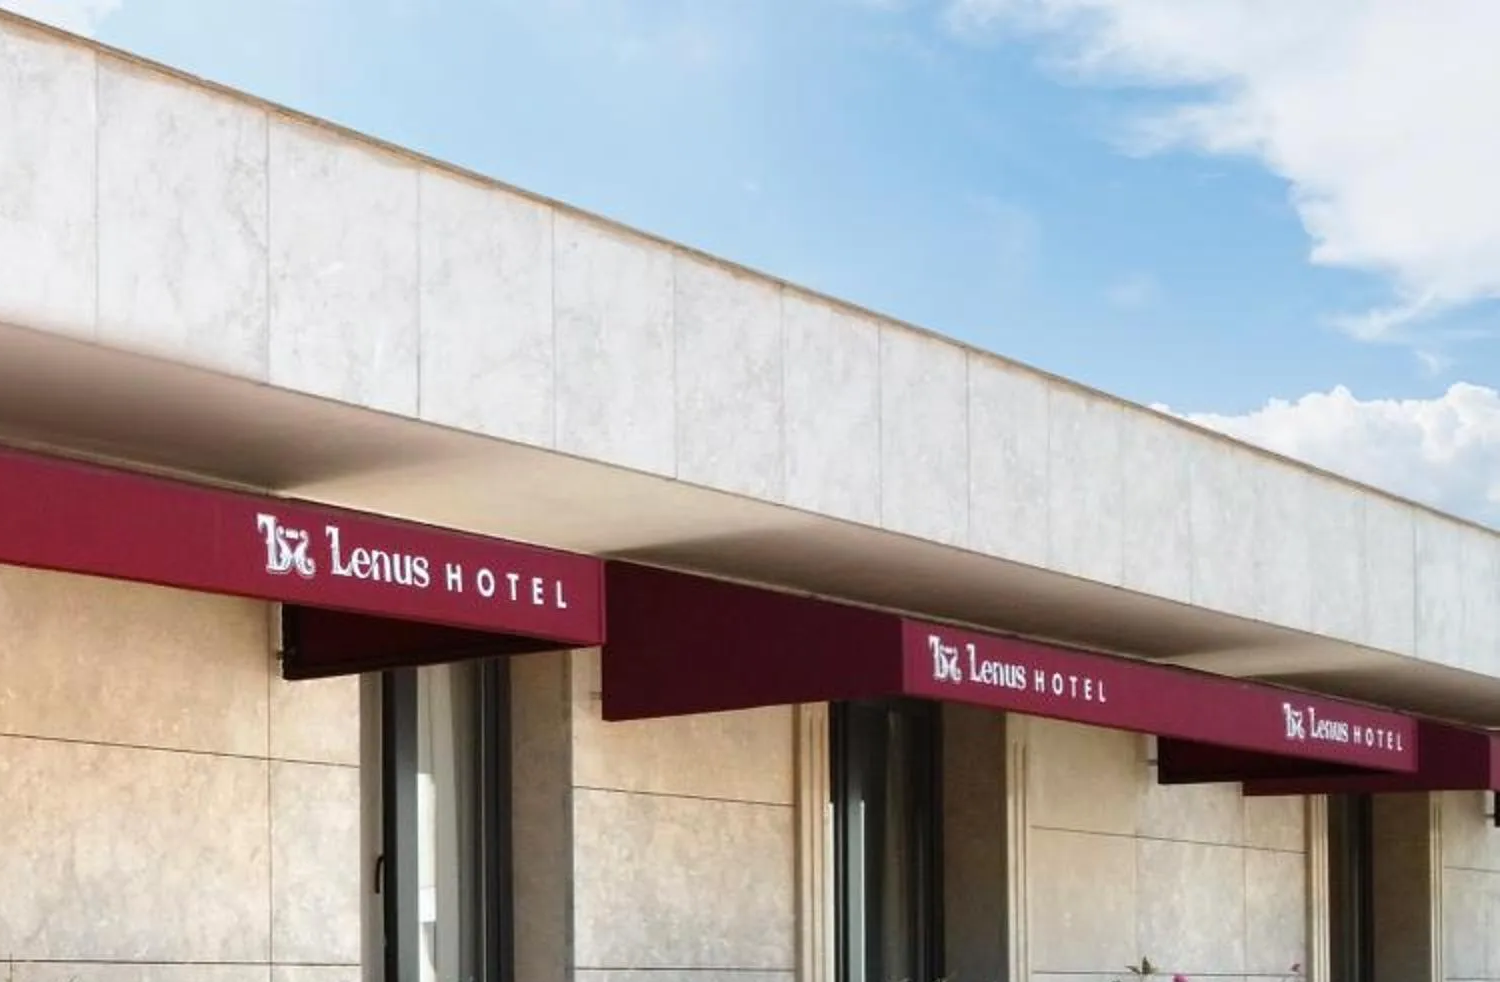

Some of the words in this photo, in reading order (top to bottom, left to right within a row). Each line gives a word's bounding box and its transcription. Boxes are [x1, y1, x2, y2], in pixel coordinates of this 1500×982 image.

[326, 525, 430, 588] Lenus
[446, 563, 566, 608] HOTEL
[966, 644, 1026, 689] Lenus
[1035, 670, 1106, 702] HOTEL
[1308, 707, 1348, 743] Lenus
[1354, 726, 1403, 751] HOTEL
